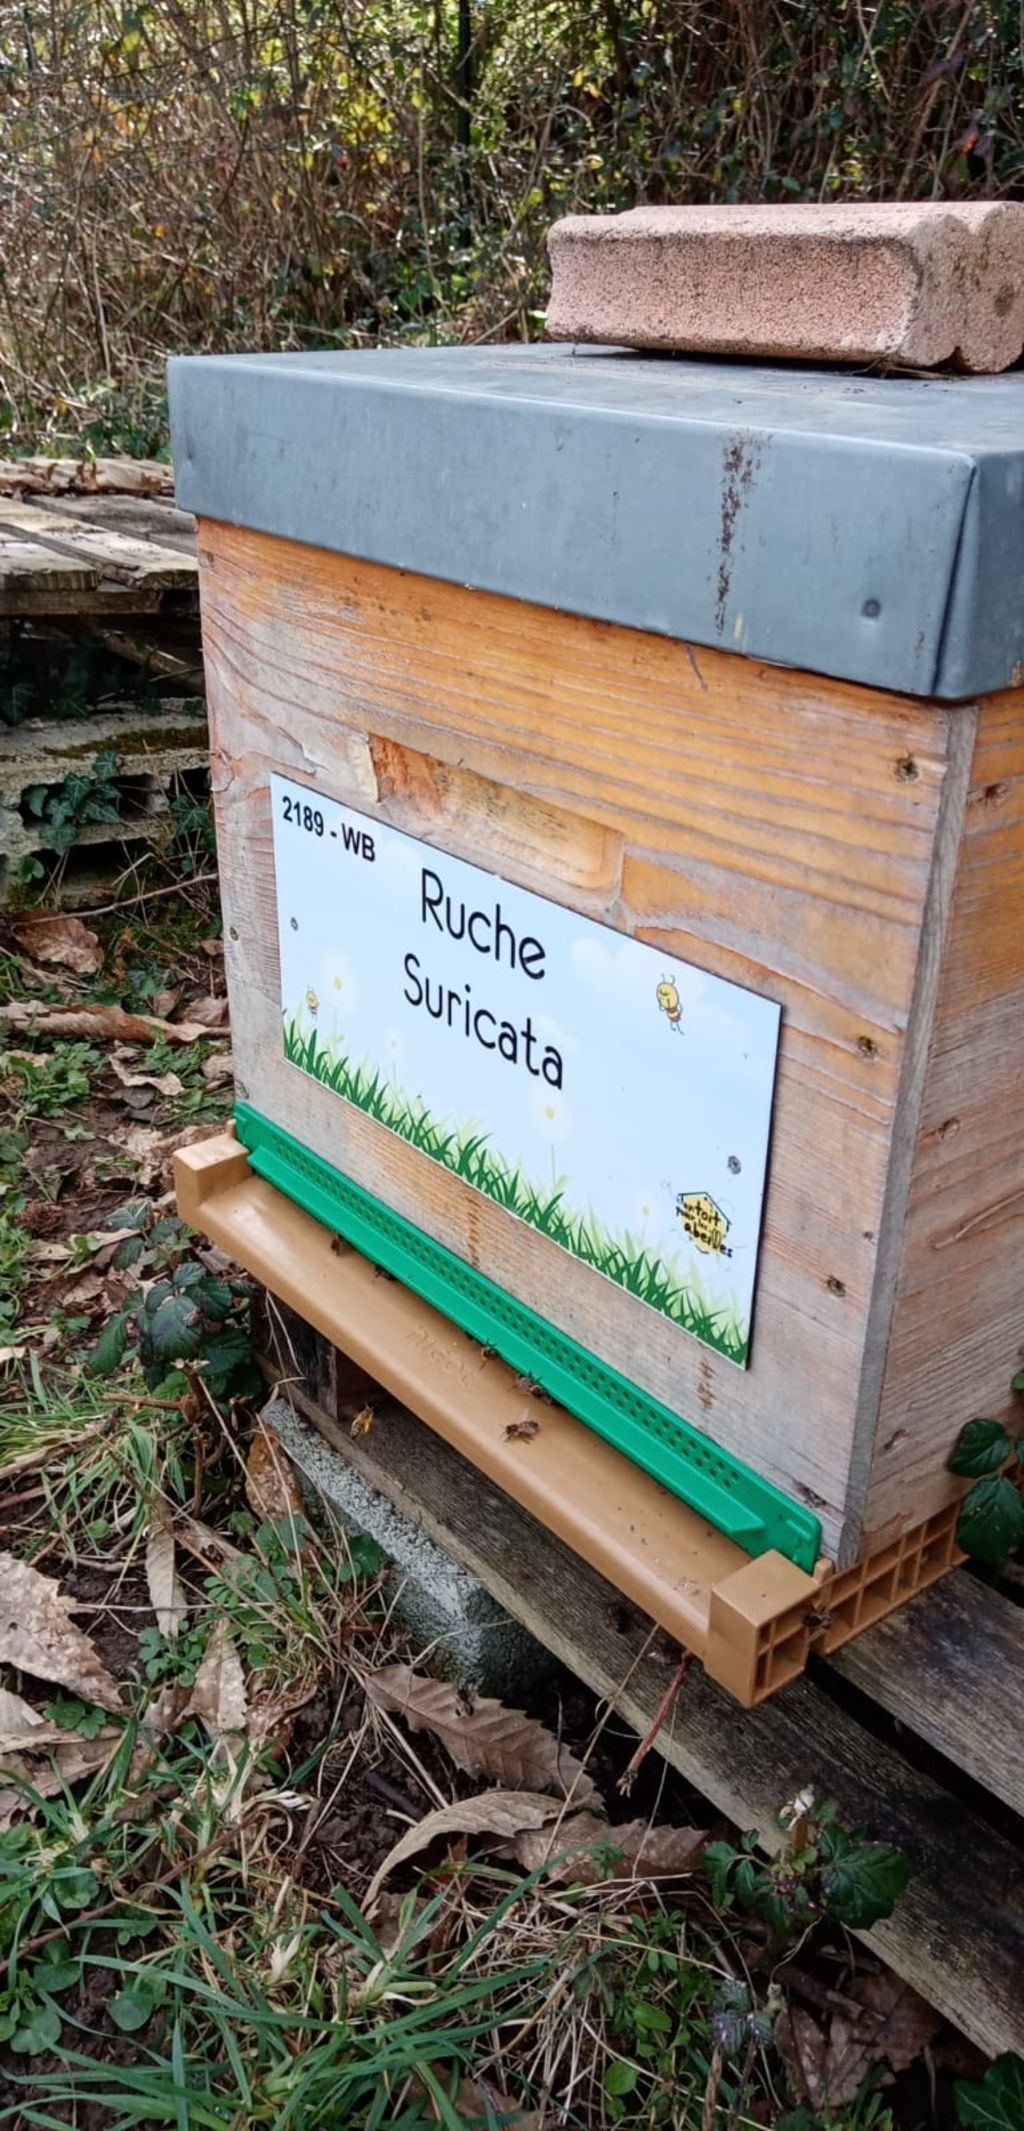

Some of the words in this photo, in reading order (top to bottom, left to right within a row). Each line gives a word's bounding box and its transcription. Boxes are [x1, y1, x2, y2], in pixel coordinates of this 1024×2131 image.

[282, 795, 325, 837] 2189
[340, 822, 377, 863] WB
[421, 867, 547, 980] Ruche
[403, 952, 564, 1091] Suricata
